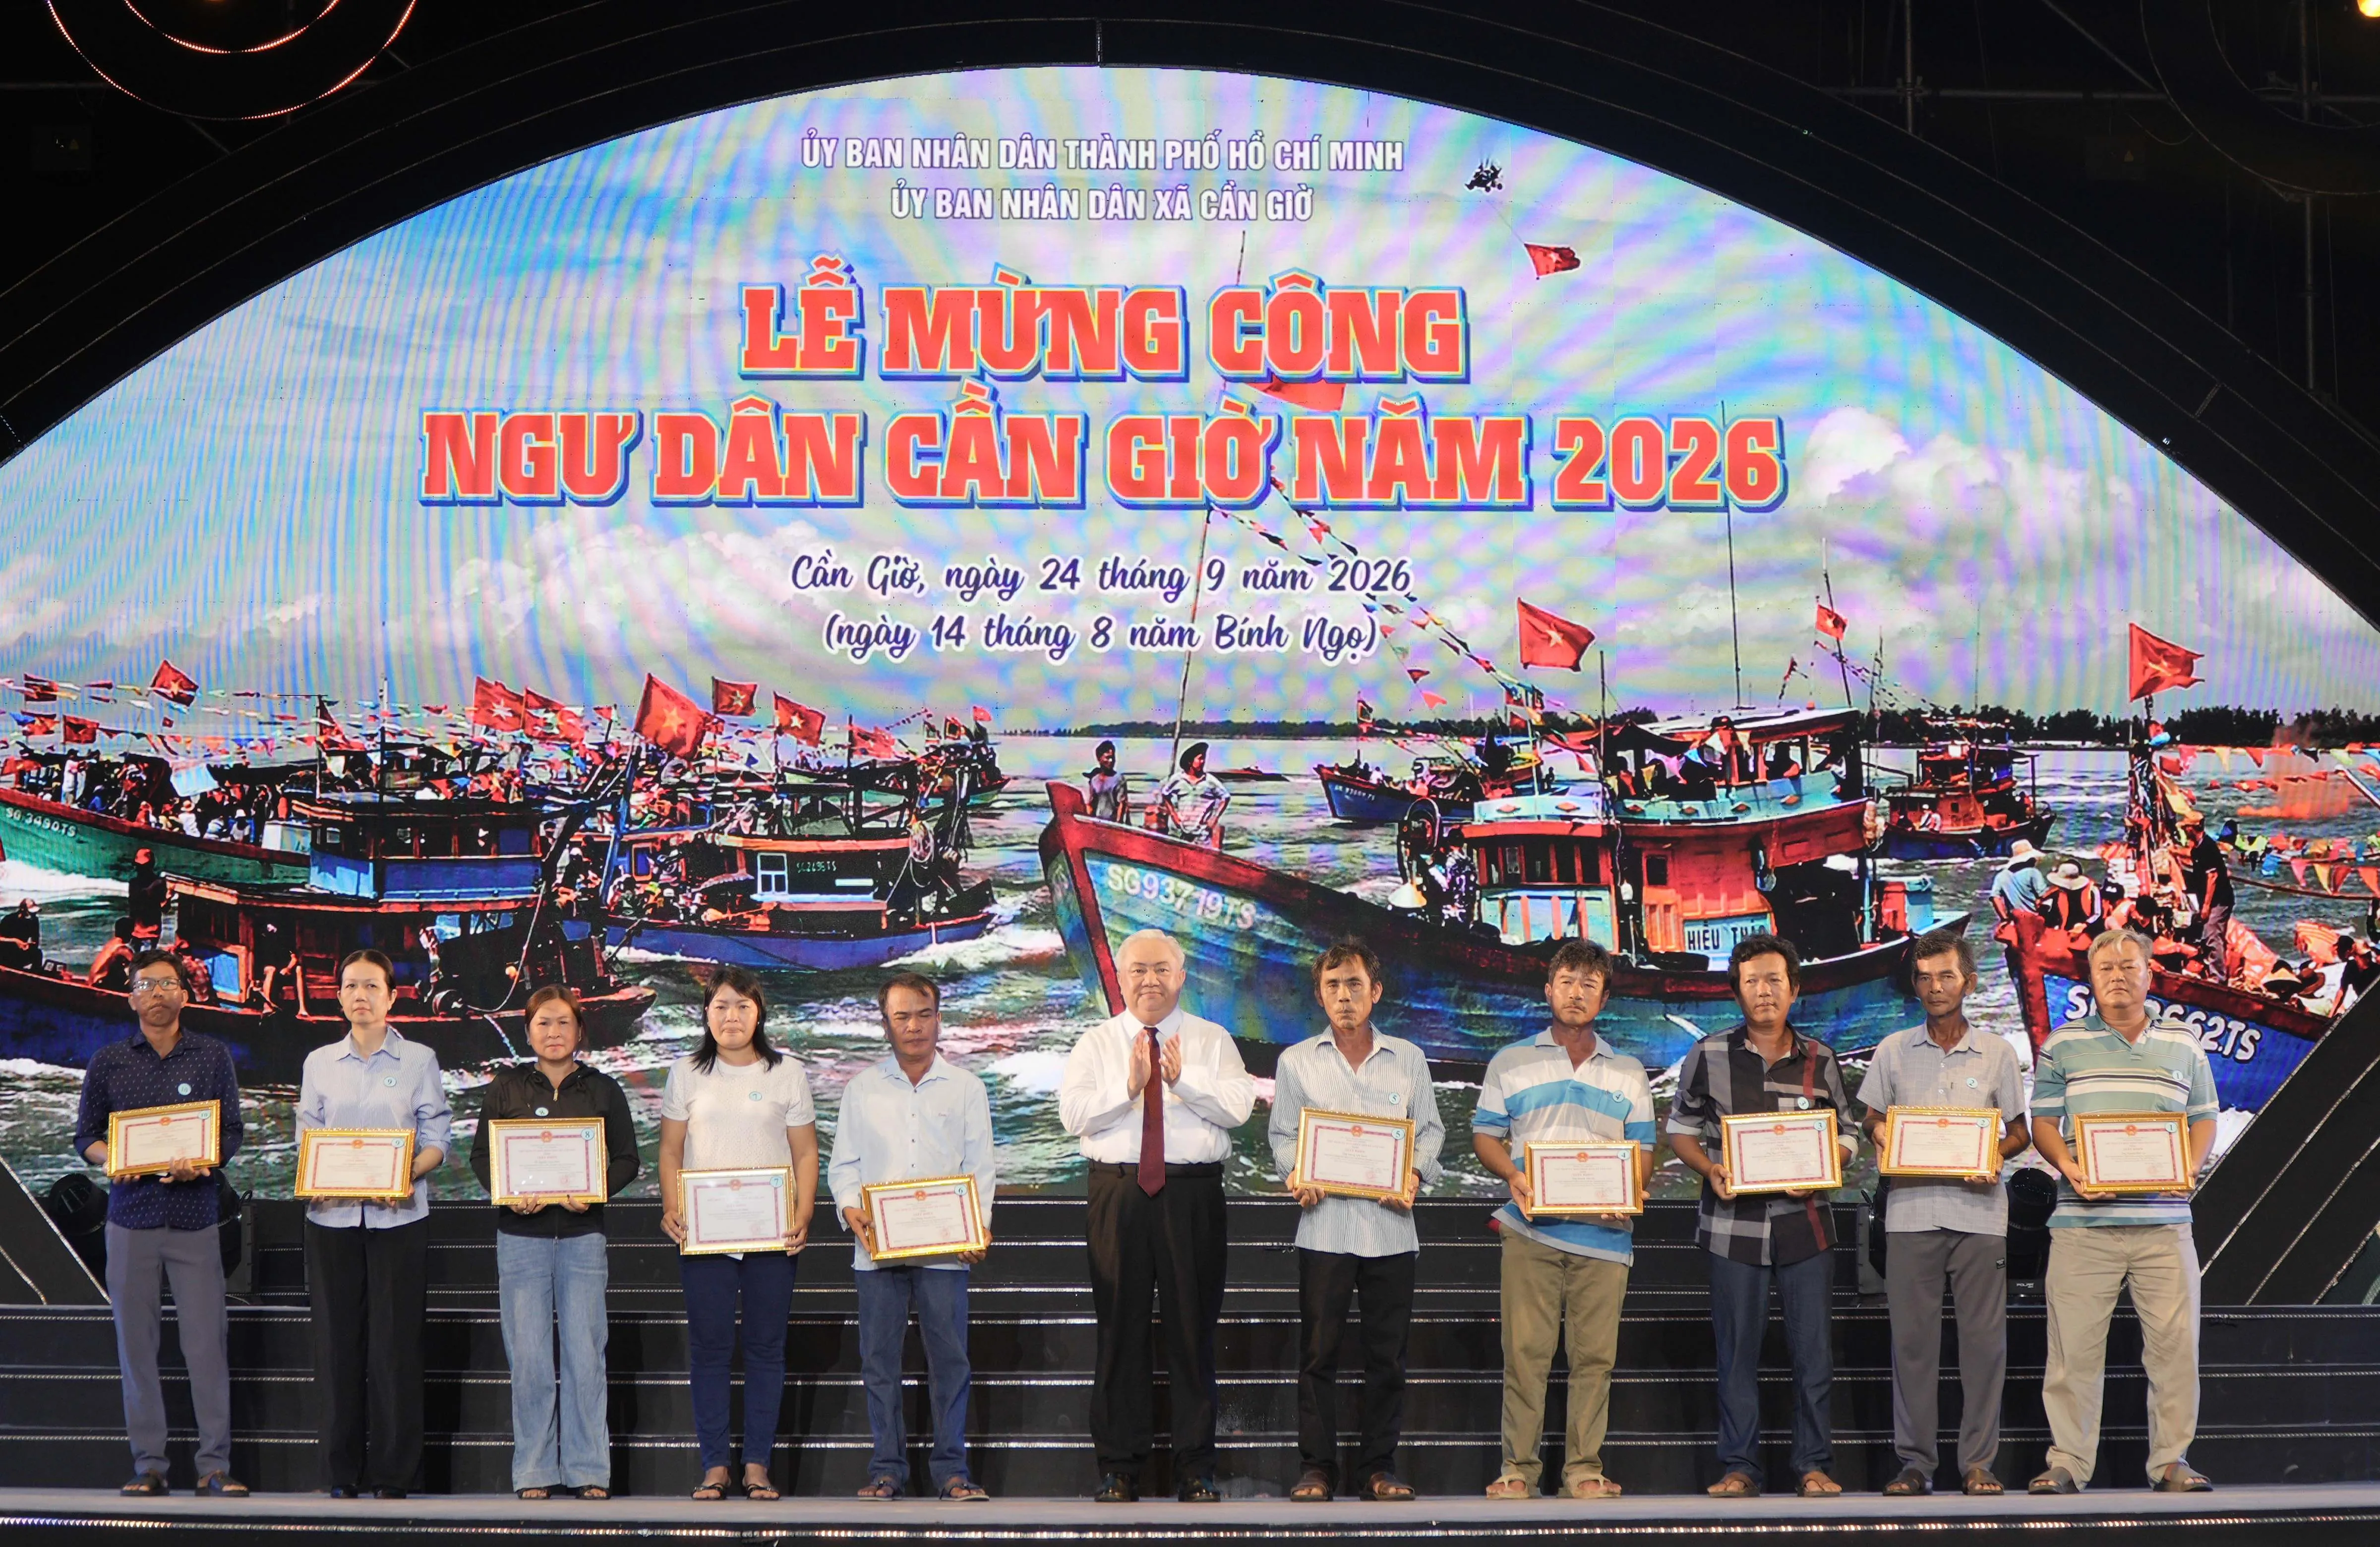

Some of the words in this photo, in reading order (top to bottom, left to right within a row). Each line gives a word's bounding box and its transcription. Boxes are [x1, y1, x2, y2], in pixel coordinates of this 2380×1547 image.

[802, 127, 838, 168] ỦY
[845, 138, 903, 168] BAN
[911, 132, 990, 169] NHÂN
[999, 133, 1056, 169] DÂN
[1064, 133, 1156, 170] THÀNH
[1164, 129, 1222, 170] PHỐ
[1228, 130, 1266, 171] HỒ
[1273, 134, 1321, 171] CHÍ
[1328, 140, 1404, 171] MINH
[891, 179, 928, 219] ỦY
[935, 188, 993, 219] BAN
[1001, 183, 1080, 219] NHÂN
[1087, 184, 1146, 220] DÂN
[1154, 184, 1192, 220] XÃ
[1200, 180, 1258, 220] CẦN
[1265, 184, 1313, 221] GIỜ
[739, 250, 864, 380] LỄ
[879, 262, 1189, 382] MỪNG
[1206, 268, 1471, 383] CÔNG
[419, 407, 644, 506] NGƯ
[652, 392, 867, 507] DÂN
[883, 377, 1089, 509] CẦN
[1105, 391, 1282, 510] GIỜ
[1290, 393, 1533, 511] NĂM
[1551, 414, 1786, 512] 2026
[793, 549, 853, 589] Cần
[867, 556, 925, 595] Giờ,
[946, 558, 1024, 602] ngày
[1040, 558, 1080, 590] 24
[1099, 557, 1190, 603] tháng
[1206, 559, 1225, 591] 9
[1243, 561, 1313, 591] năm
[1328, 559, 1411, 591] 2026
[826, 614, 917, 659] (ngày
[932, 616, 965, 647] 14
[985, 614, 1075, 660] tháng
[1091, 616, 1113, 647] 8
[1130, 618, 1200, 648] năm
[1215, 614, 1289, 648] Bính
[1304, 615, 1376, 661] Ngọ)
